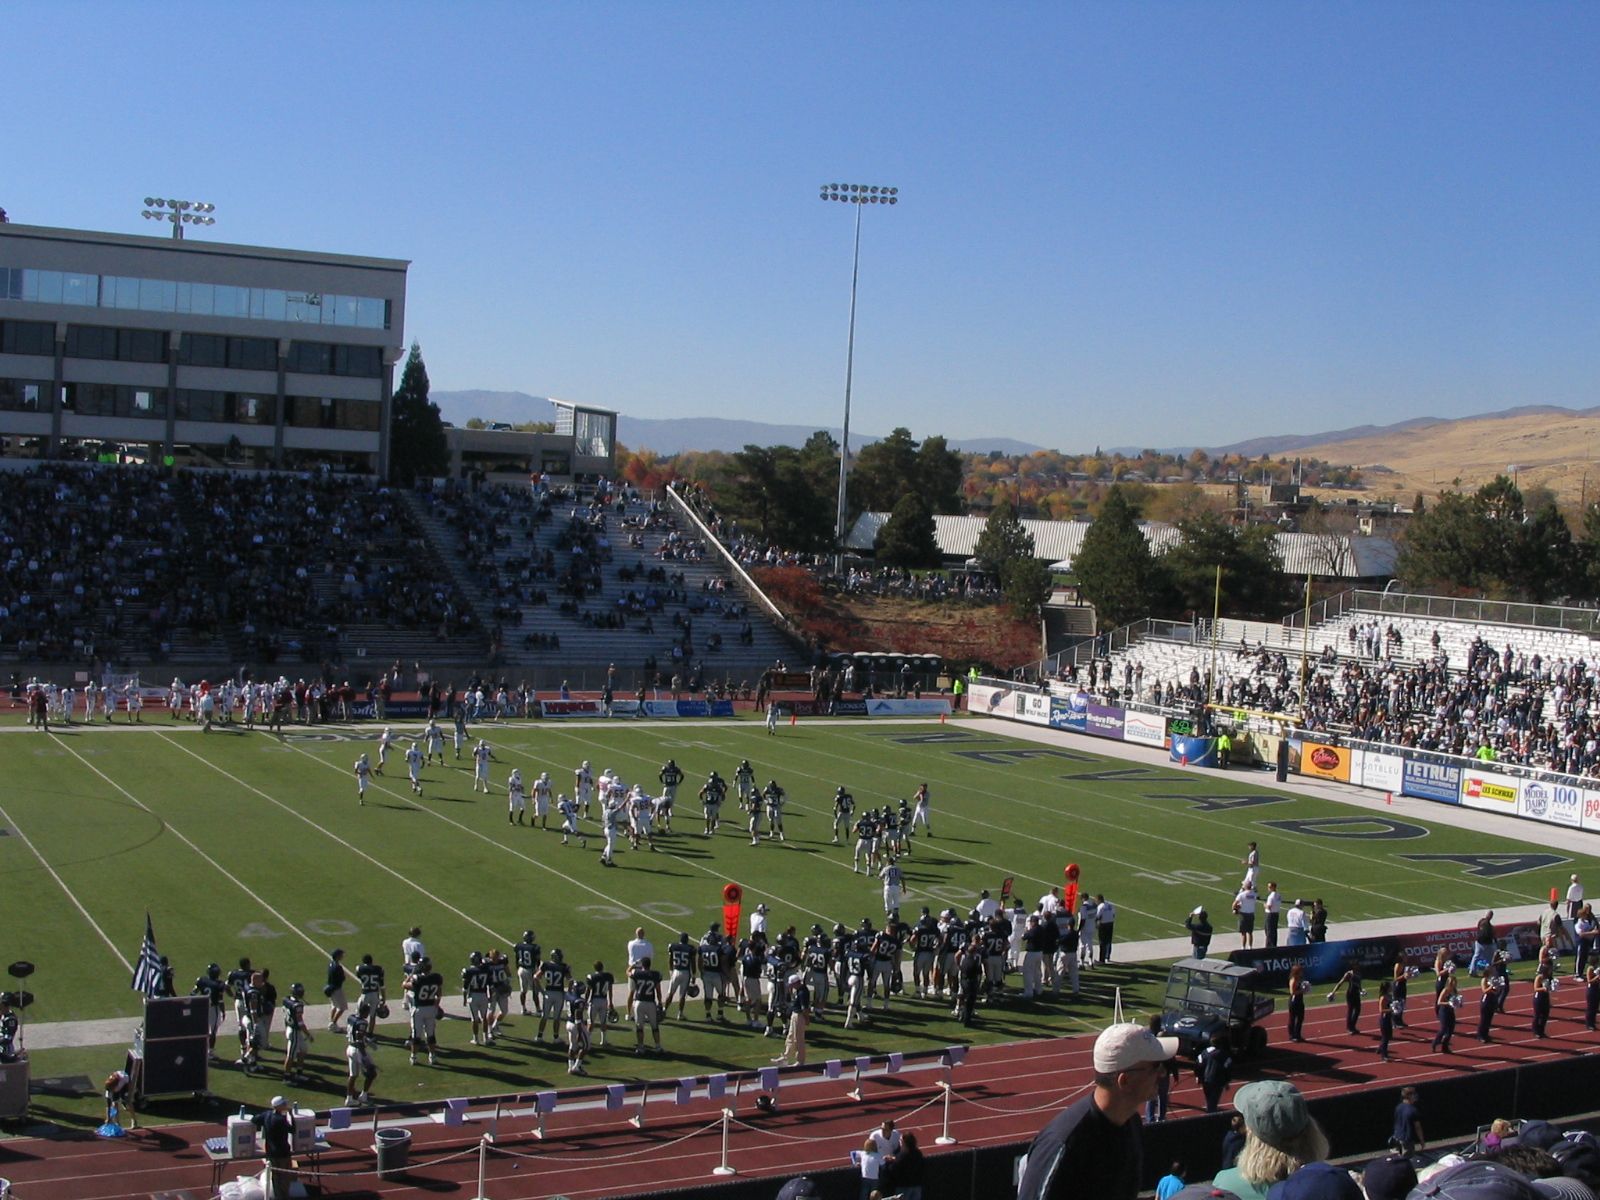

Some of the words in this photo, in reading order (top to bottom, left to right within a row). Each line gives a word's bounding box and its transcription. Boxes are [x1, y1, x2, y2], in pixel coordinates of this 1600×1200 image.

[1405, 759, 1460, 782] TETRUS
[1524, 788, 1548, 799] MODEL
[1552, 787, 1577, 806] 100
[1425, 932, 1470, 943] WELCOME
[879, 940, 897, 957] 82
[1404, 944, 1446, 957] DODGE
[672, 951, 689, 967] 55
[361, 974, 379, 990] 25
[470, 973, 488, 989] 47
[544, 970, 563, 987] 92
[418, 984, 438, 1000] 62
[595, 980, 609, 995] 14
[636, 980, 656, 996] 72
